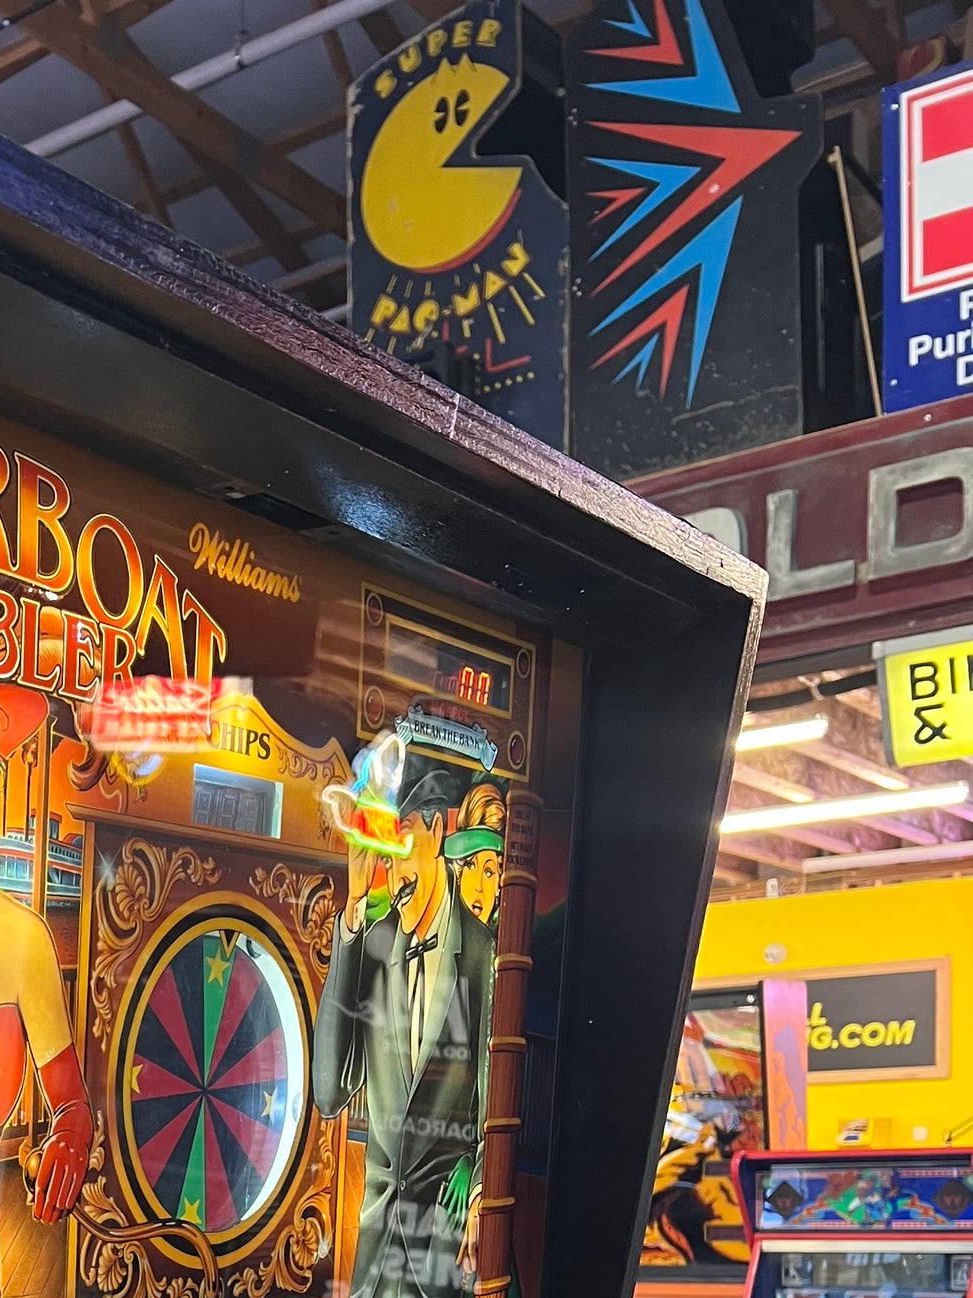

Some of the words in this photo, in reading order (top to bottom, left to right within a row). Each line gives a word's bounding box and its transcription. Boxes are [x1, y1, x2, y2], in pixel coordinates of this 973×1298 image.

[374, 18, 502, 98] SUPER
[908, 321, 973, 367] Pur
[189, 523, 300, 602] Williams
[208, 720, 272, 761] CHIPS
[414, 719, 441, 740] BREAK
[442, 728, 458, 744] THE
[914, 703, 952, 744] &
[807, 1019, 916, 1050] G.COM
